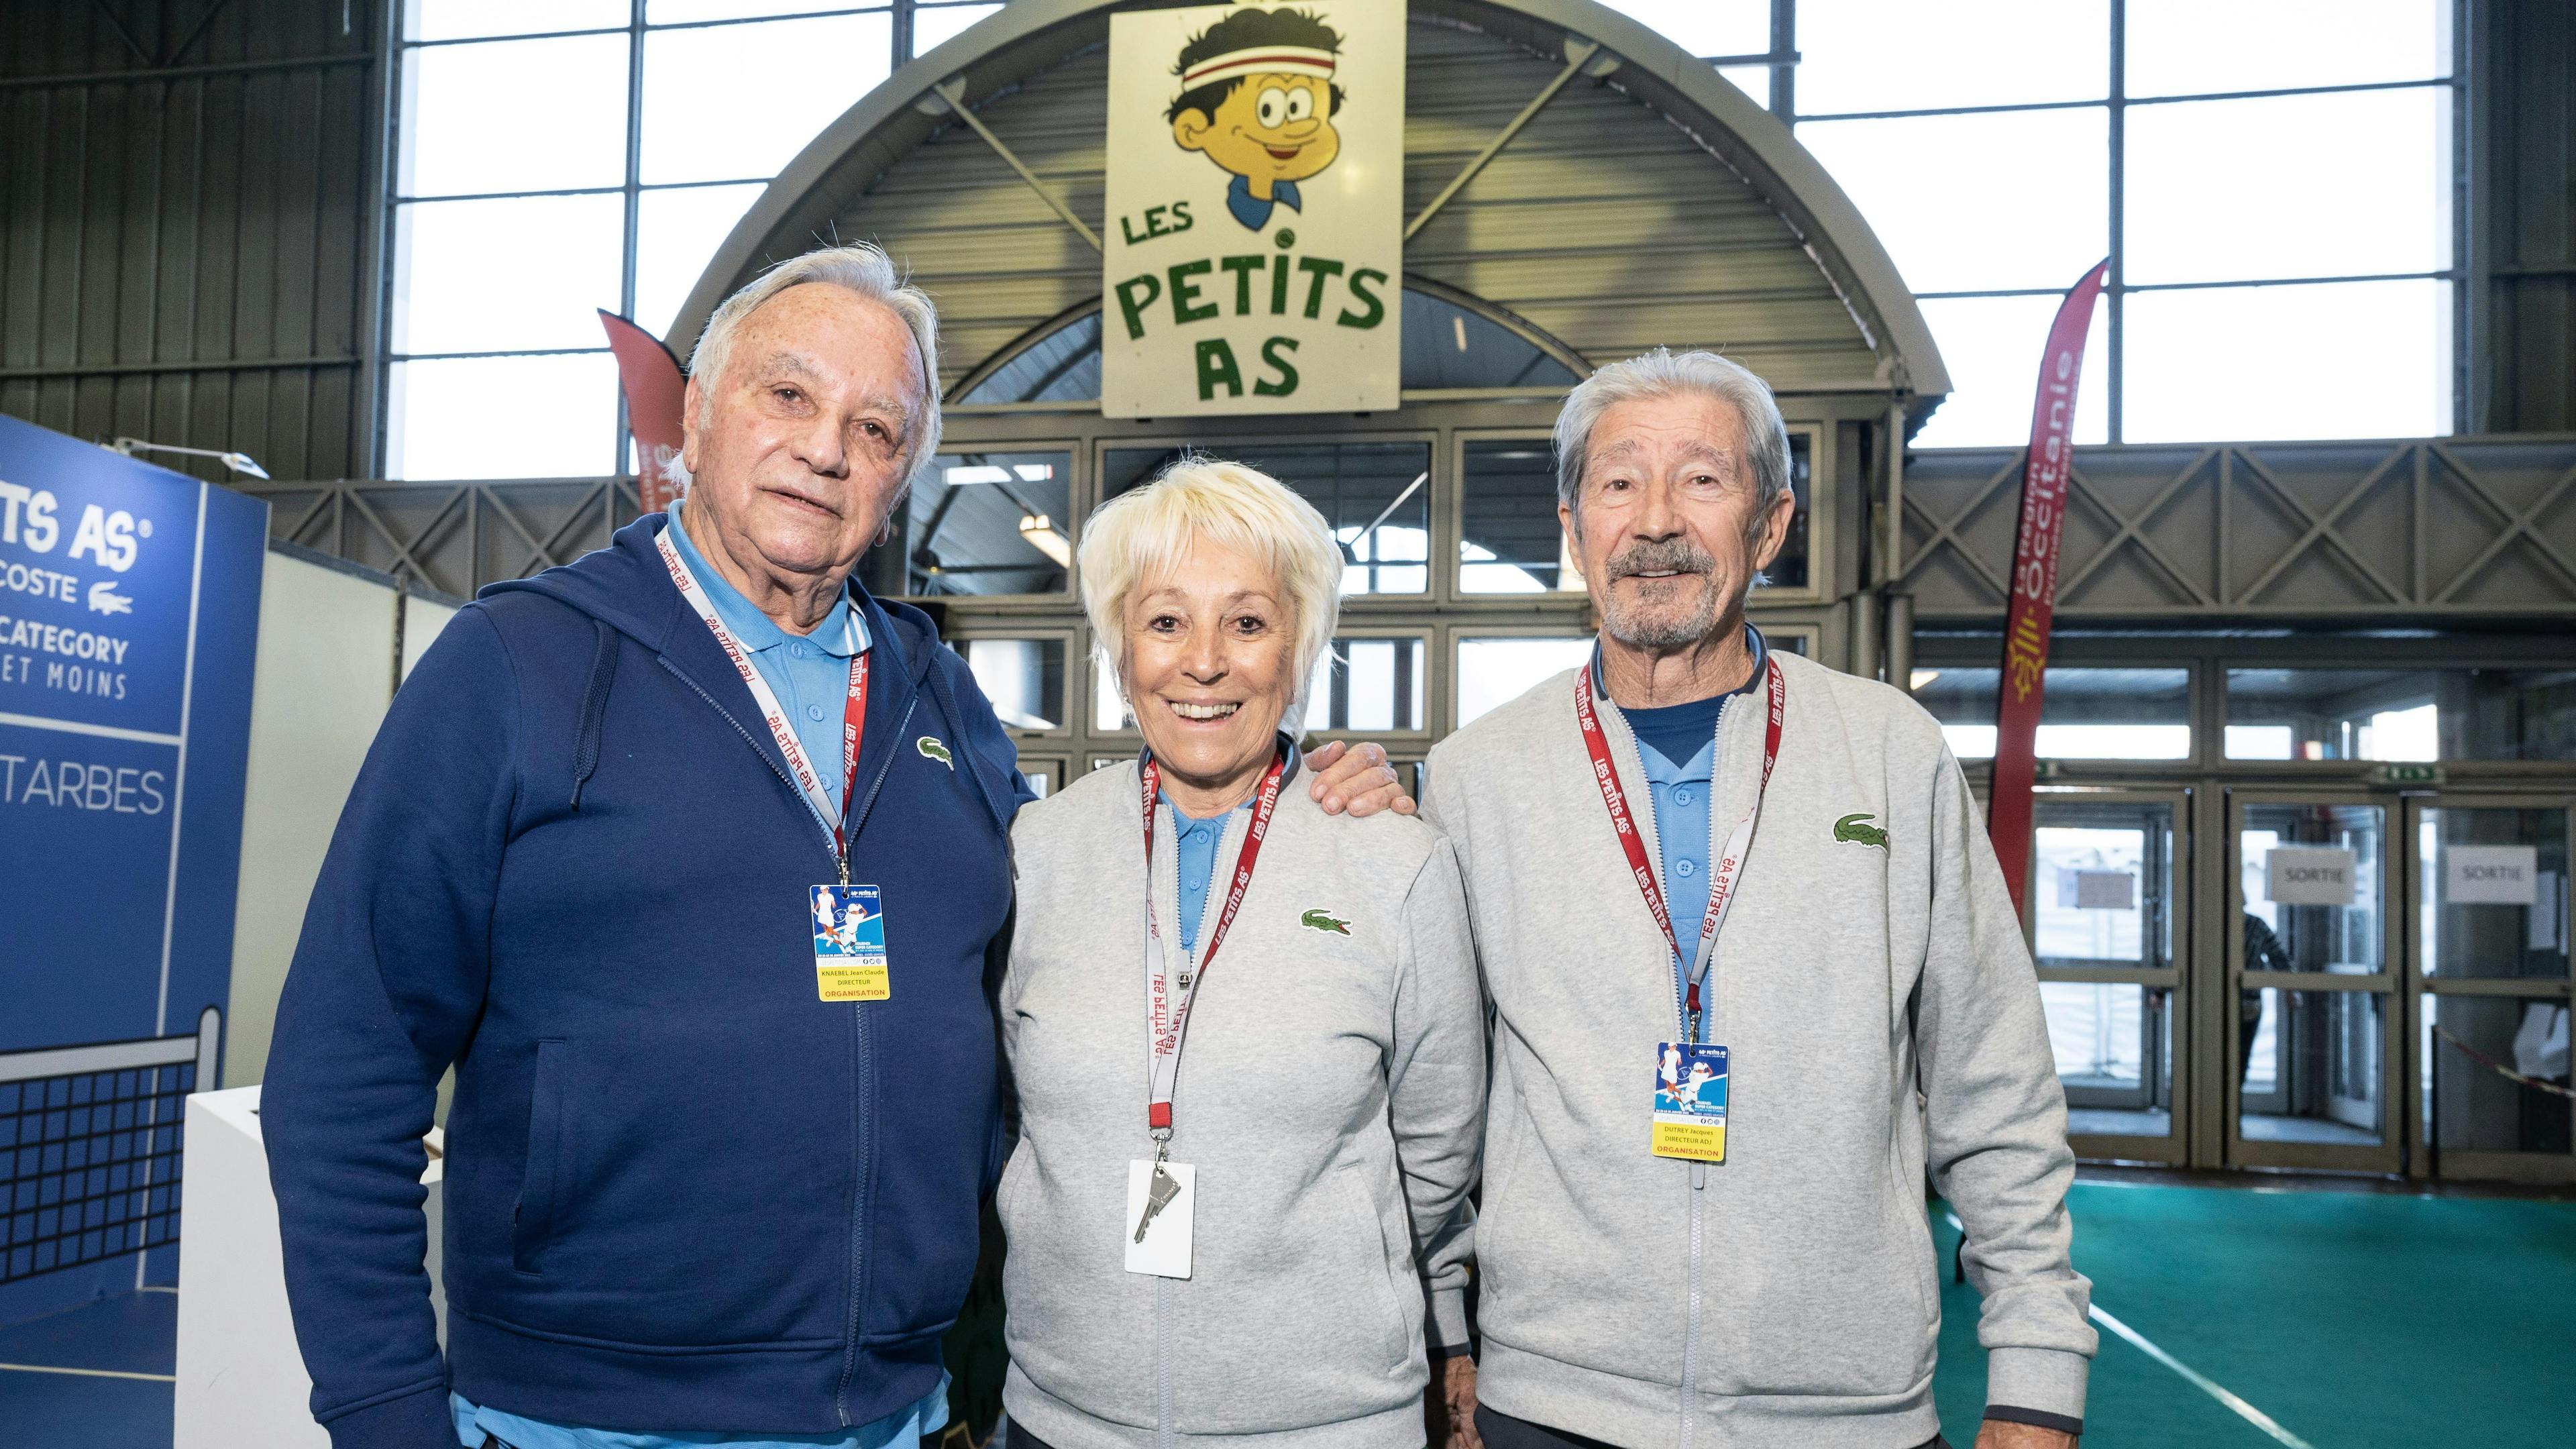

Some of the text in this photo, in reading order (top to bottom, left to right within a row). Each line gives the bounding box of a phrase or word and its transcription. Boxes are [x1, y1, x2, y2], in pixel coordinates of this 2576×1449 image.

[1121, 201, 1194, 246] LES
[1195, 336, 1300, 401] AS
[2025, 350, 2072, 600] Occitanie
[2, 653, 126, 700] ET MOINS
[1772, 708, 1782, 727] LES
[845, 722, 857, 741] LES
[1594, 758, 1610, 779] LES
[0, 754, 164, 816] TARBES
[1252, 820, 1267, 842] LES
[1635, 865, 1651, 889] LES
[2284, 866, 2346, 883] SORTIE
[2461, 864, 2523, 881] SORTIE
[1215, 924, 1227, 945] LES
[825, 989, 885, 998] ORGANISATION
[1665, 1136, 1699, 1144] DIRECTEUR
[1690, 1128, 1714, 1136] Jacques
[1657, 1145, 1719, 1157] ORGANISATION
